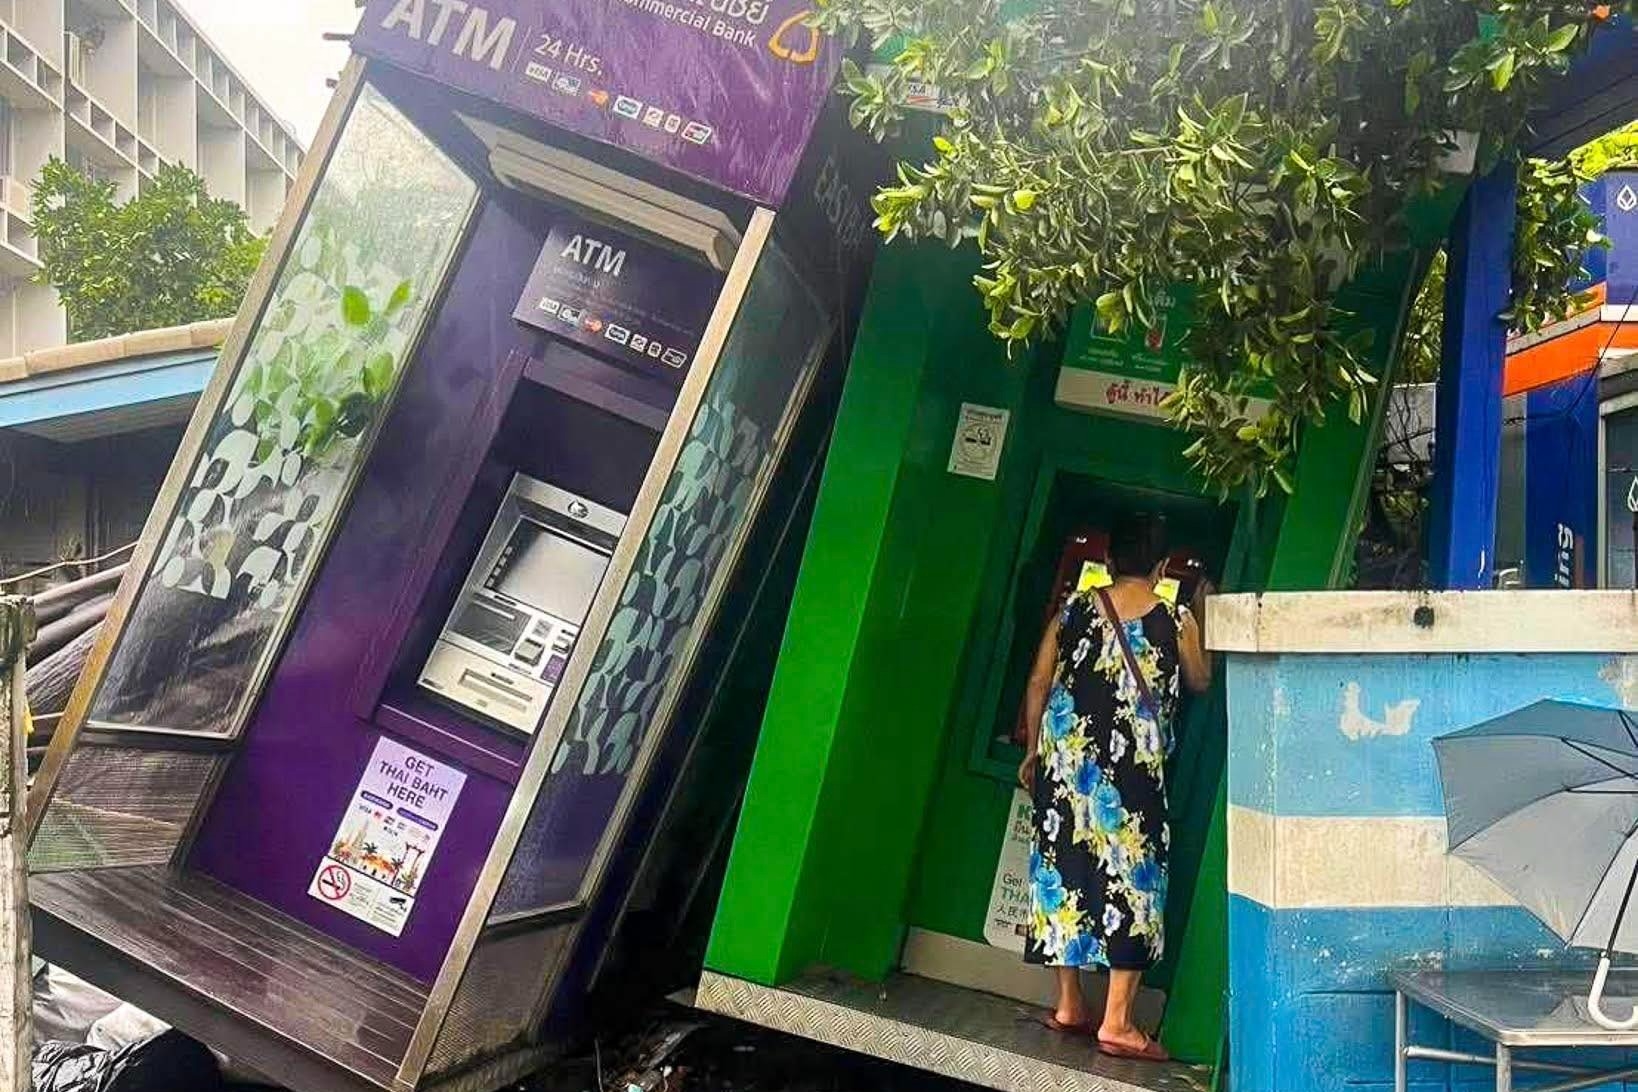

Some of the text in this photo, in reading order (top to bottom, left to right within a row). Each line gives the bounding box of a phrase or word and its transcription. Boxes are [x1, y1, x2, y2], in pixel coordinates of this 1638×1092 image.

[380, 0, 517, 71] ATM
[712, 19, 757, 47] Bank
[534, 34, 604, 76] 24 Hrs.
[561, 234, 627, 277] ATM
[379, 760, 410, 783] THAI
[413, 777, 449, 801] BAHT
[404, 756, 435, 777] GET
[386, 782, 426, 809] HERE
